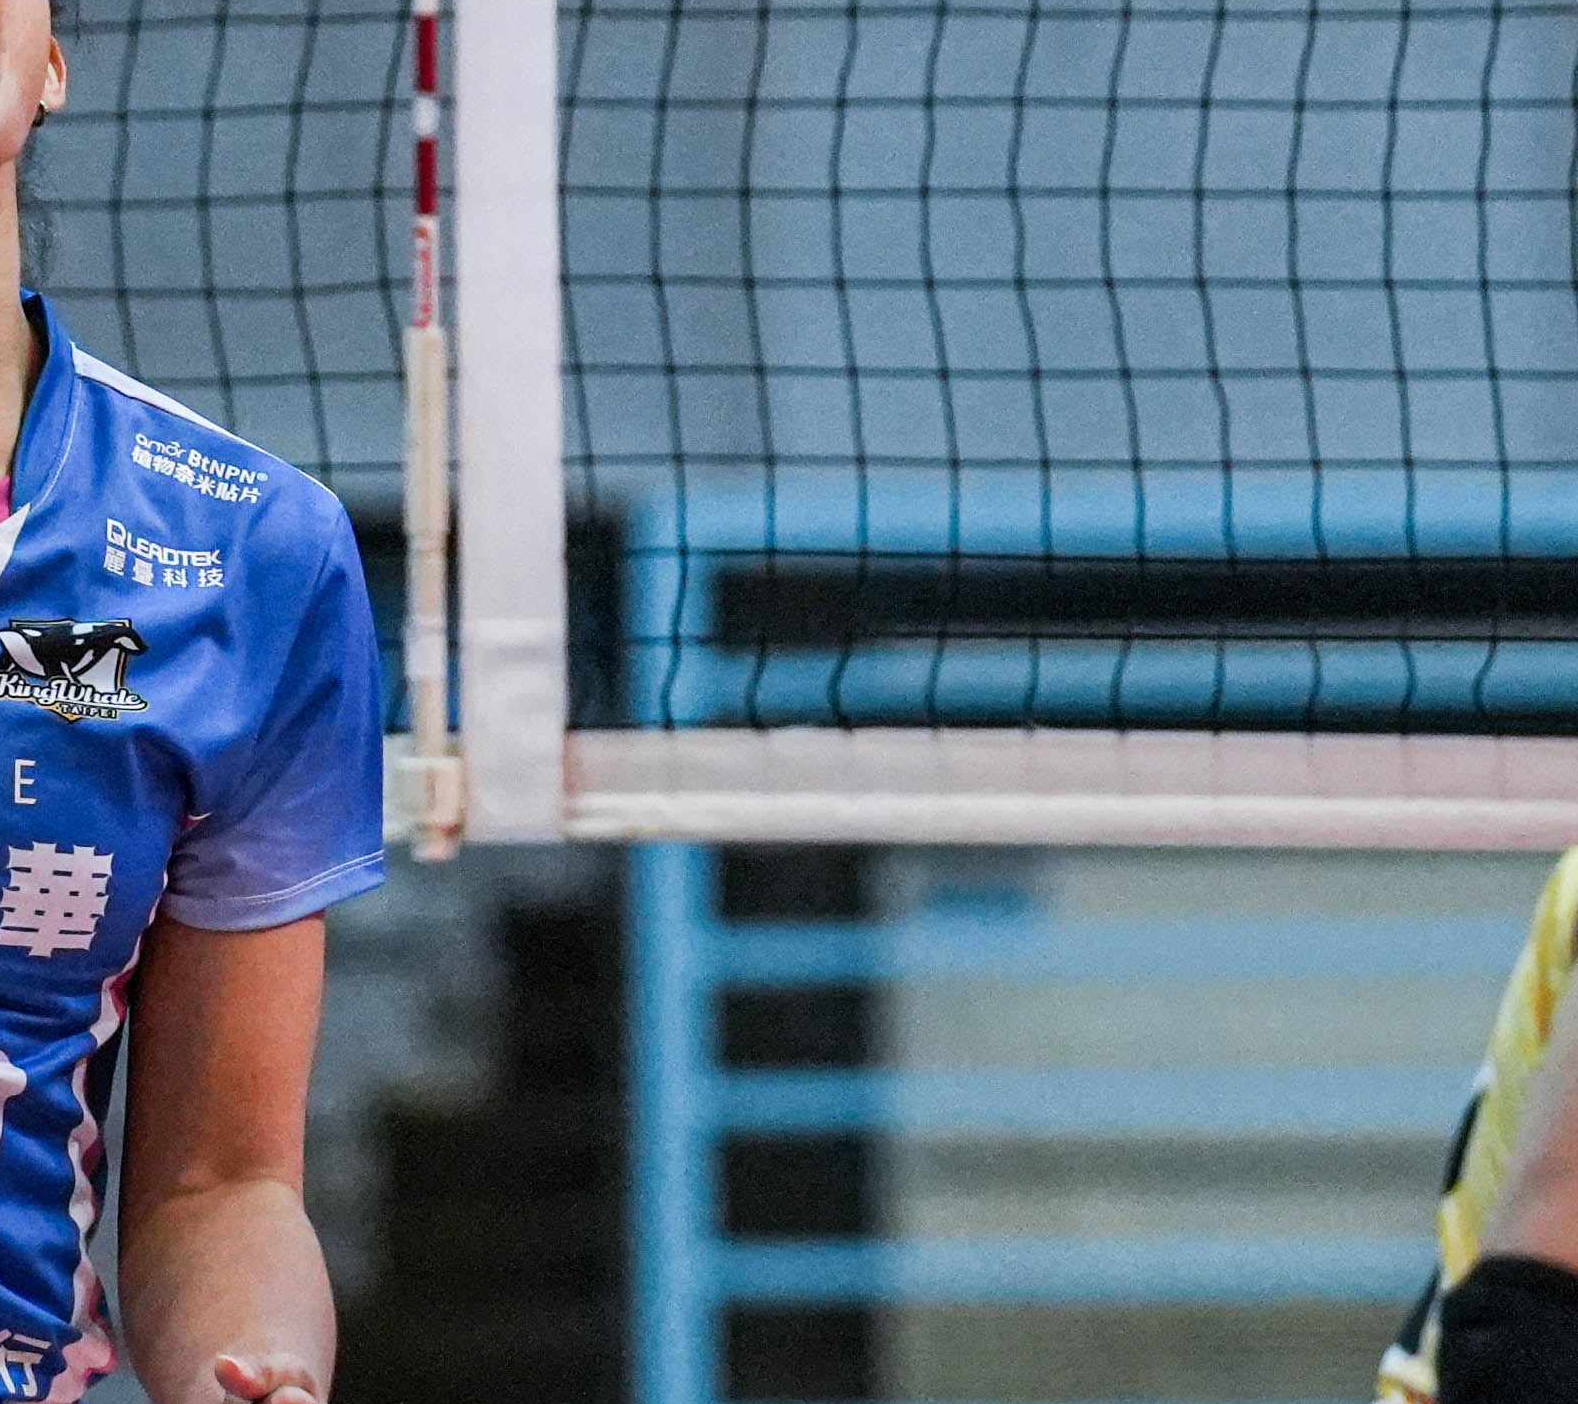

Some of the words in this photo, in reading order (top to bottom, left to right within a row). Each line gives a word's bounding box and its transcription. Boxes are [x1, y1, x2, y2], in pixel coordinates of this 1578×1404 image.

[131, 445, 262, 504] 植物奈米貼片
[61, 702, 119, 719] TAIPEI
